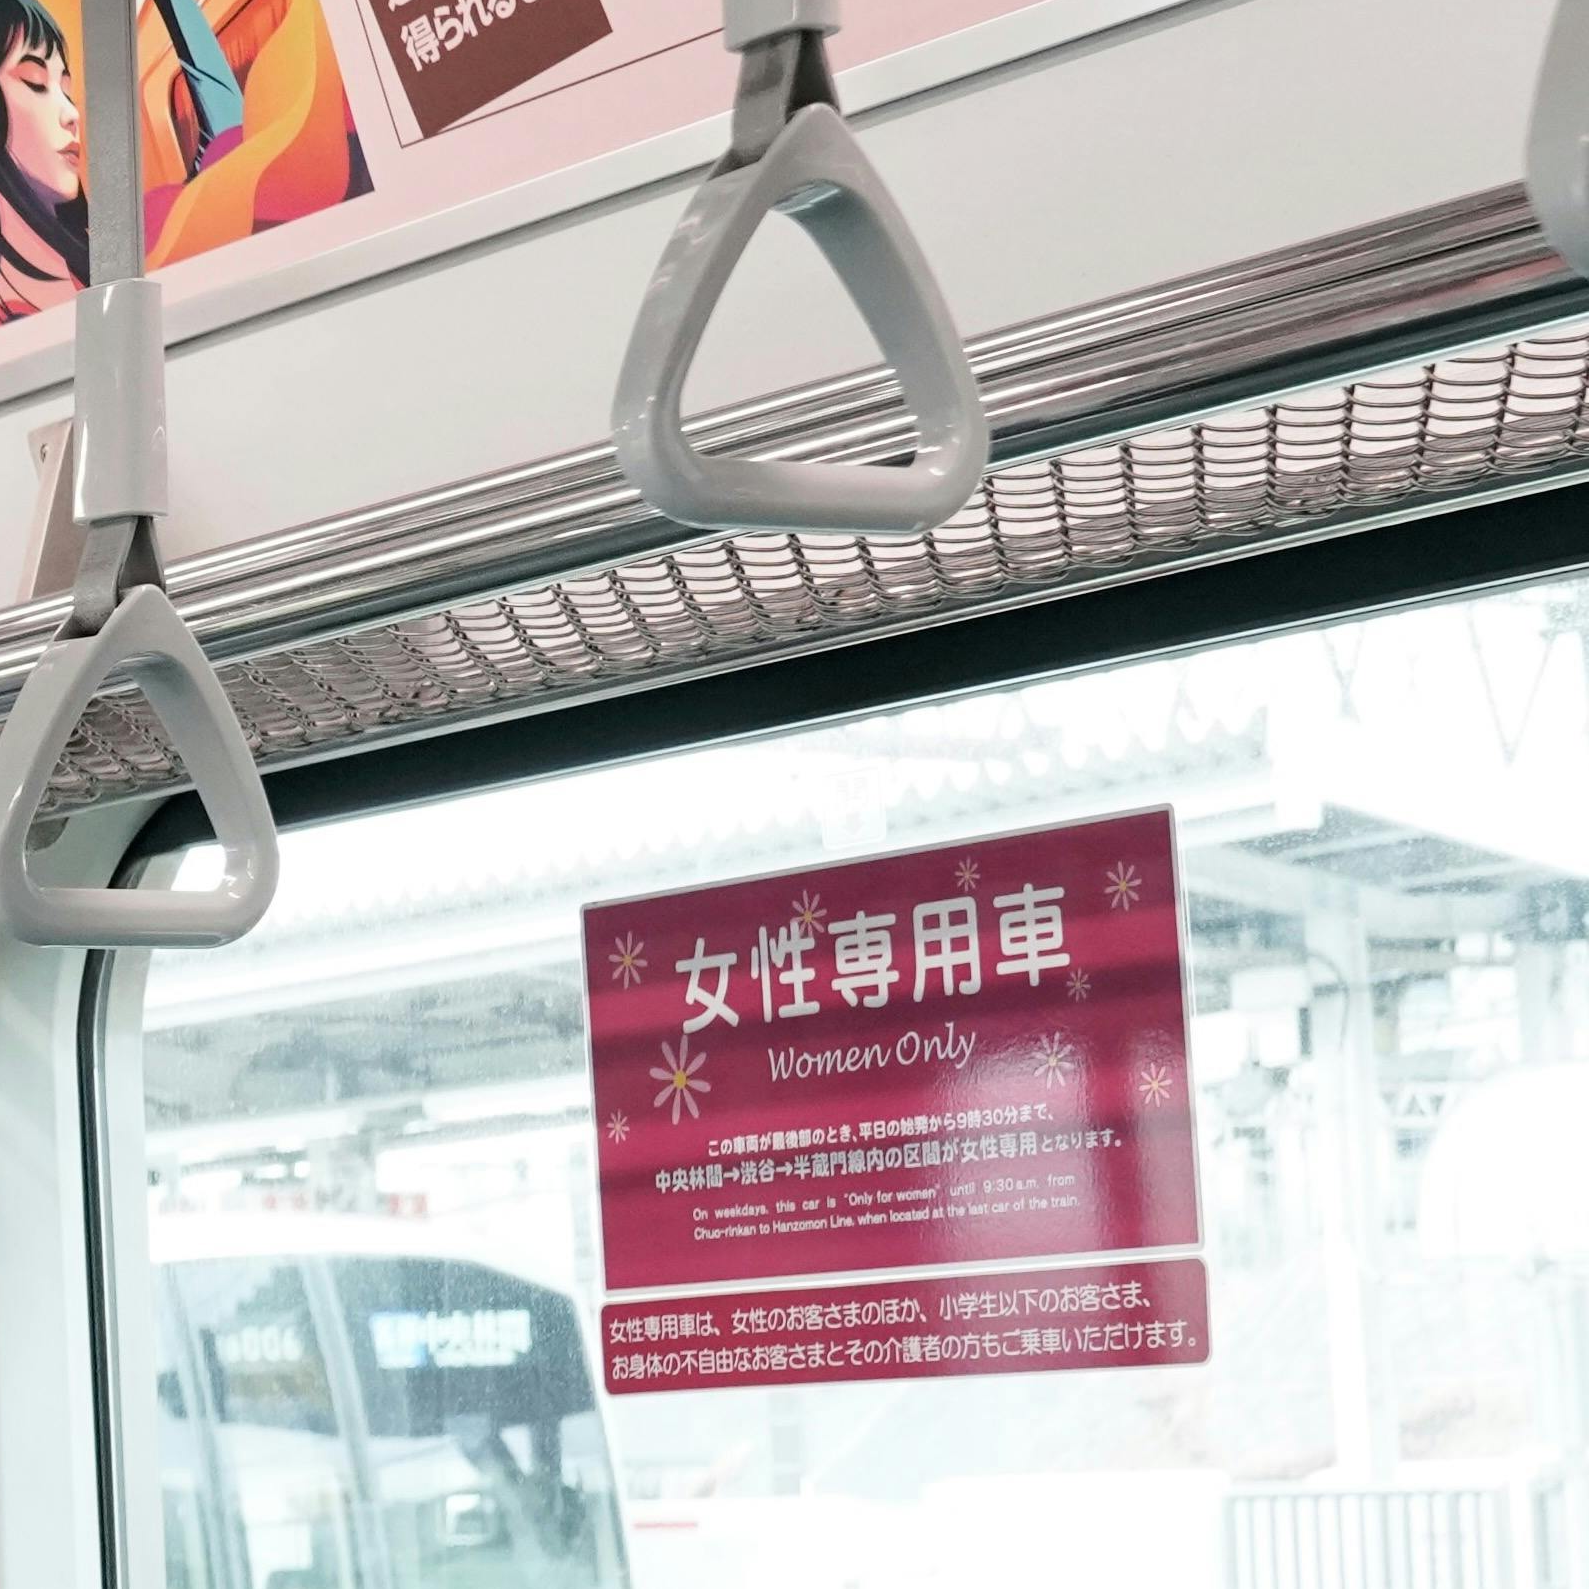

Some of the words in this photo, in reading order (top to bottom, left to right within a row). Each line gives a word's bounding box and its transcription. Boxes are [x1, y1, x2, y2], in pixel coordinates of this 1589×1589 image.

[674, 882, 1072, 1035] 女性専用車
[767, 1041, 891, 1083] Women
[893, 1022, 977, 1068] Only
[692, 1207, 709, 1222] On
[775, 1198, 796, 1214] this
[802, 1198, 820, 1211] car
[826, 1194, 837, 1209] is
[876, 1189, 892, 1204] for
[1047, 1173, 1075, 1187] from
[693, 1224, 757, 1241] Chuo-rinkan
[759, 1223, 771, 1235] to
[772, 1218, 829, 1235] Hanzomon
[857, 1211, 887, 1226] when
[889, 1206, 930, 1223] located
[931, 1207, 944, 1220] at
[947, 1203, 966, 1218] the
[991, 1202, 1009, 1214] car
[1028, 1196, 1048, 1211] the
[611, 1318, 1198, 1381] お身体の不自由なお客さまとその介護者の方もご乗車いただけます。
